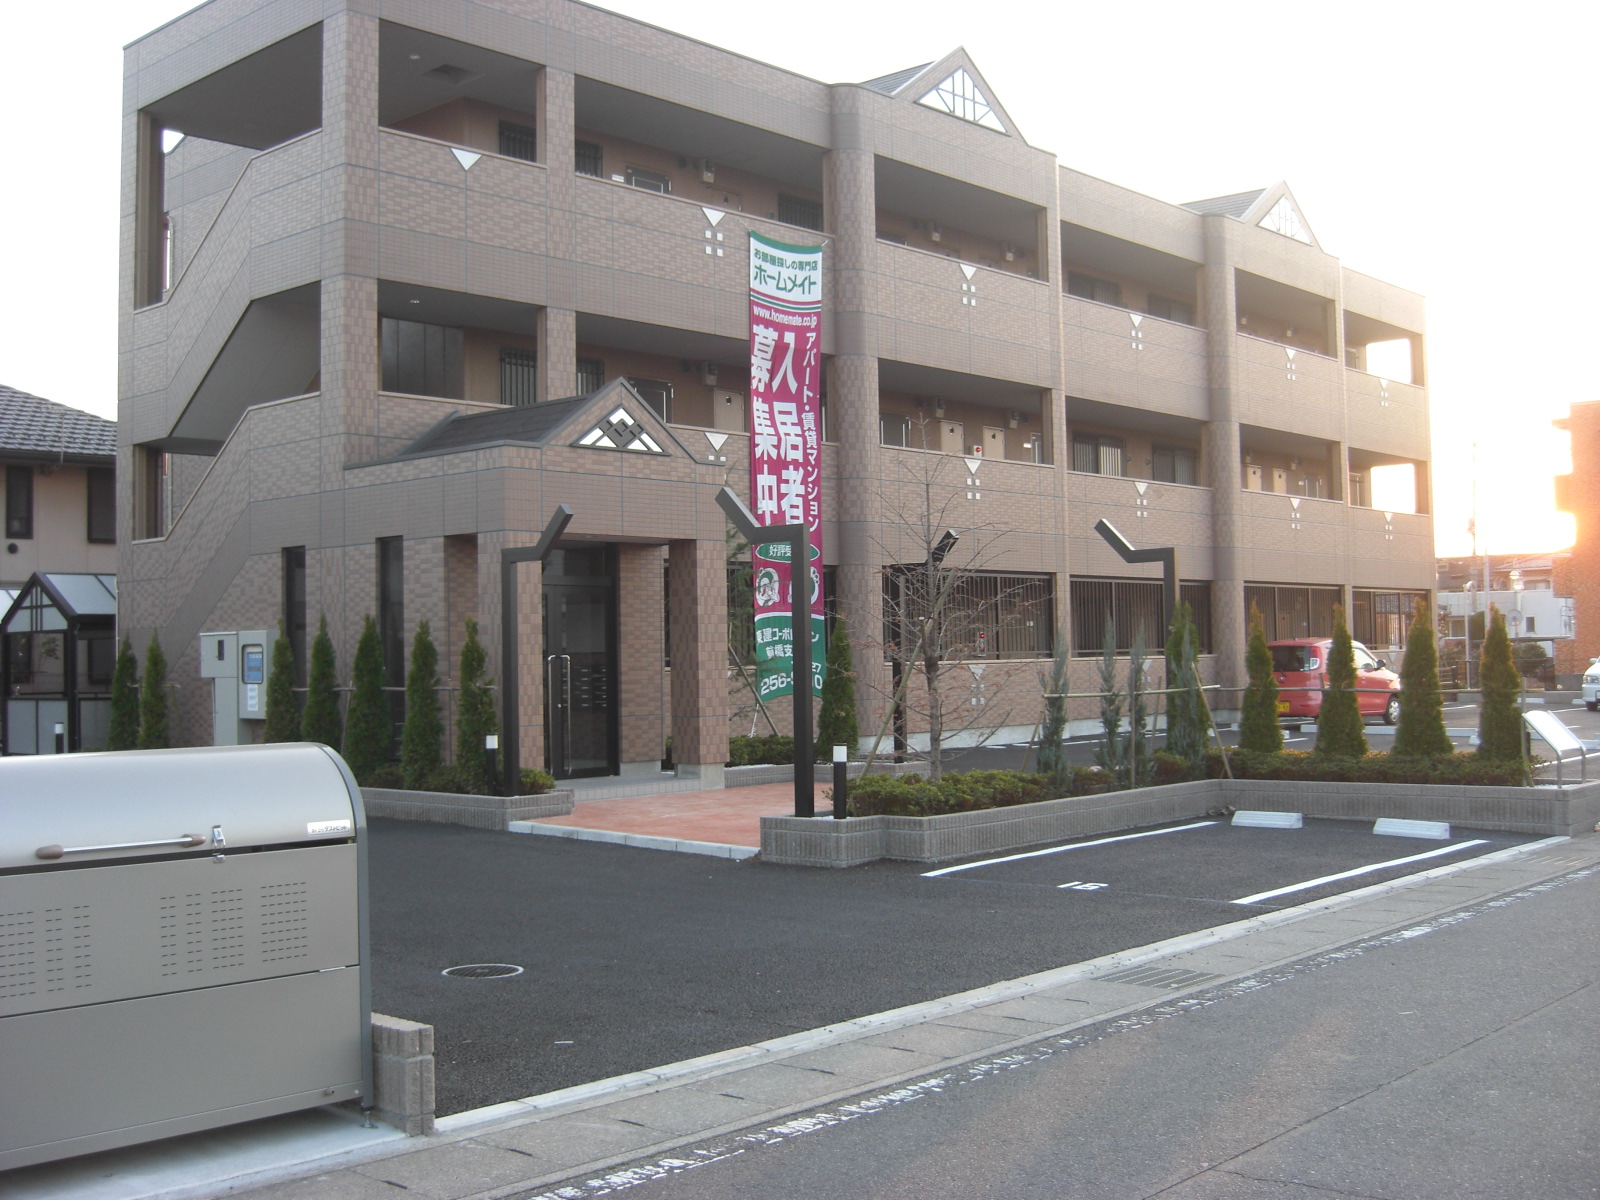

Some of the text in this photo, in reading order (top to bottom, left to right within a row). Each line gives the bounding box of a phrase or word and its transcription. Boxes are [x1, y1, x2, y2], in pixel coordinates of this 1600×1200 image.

[754, 248, 818, 271] お部屋探しの専門店
[754, 264, 817, 295] ホームメイト
[753, 305, 818, 329] www.homemate.co.jp
[769, 544, 792, 557] 好評受
[765, 644, 794, 660] 前橋支
